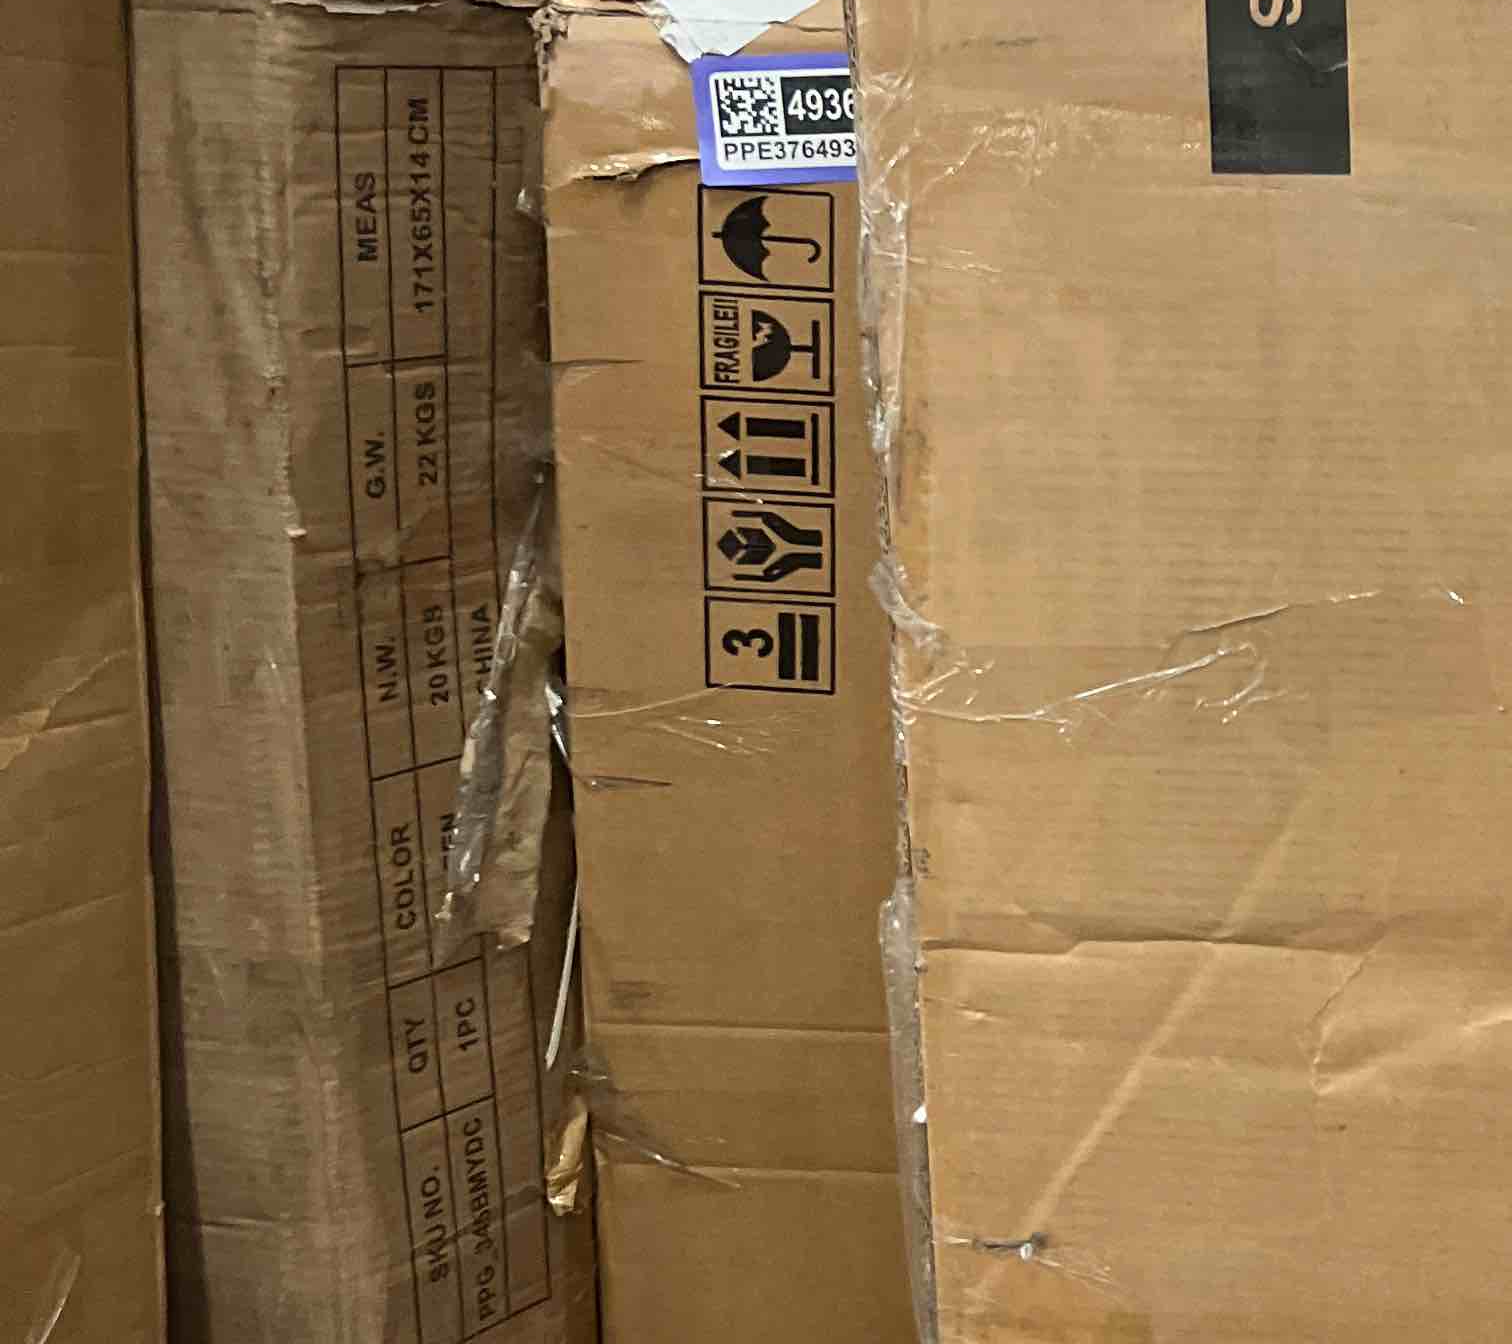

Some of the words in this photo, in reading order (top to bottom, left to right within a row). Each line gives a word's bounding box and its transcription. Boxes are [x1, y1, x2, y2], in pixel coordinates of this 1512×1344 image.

[408, 96, 429, 145] CM
[724, 139, 856, 161] PPE376493
[355, 172, 378, 262] MEAS
[409, 152, 434, 313] 171X65X14
[414, 381, 436, 447] KGS
[366, 432, 386, 498] G.W.
[417, 455, 438, 486] 22
[375, 635, 397, 703] N.W.
[721, 628, 774, 658] 3
[430, 673, 449, 706] 20
[391, 825, 416, 930] COLOR
[405, 1018, 428, 1074] QTY
[456, 997, 479, 1052] 1PC
[421, 1166, 444, 1220] NO.
[426, 1222, 449, 1283] SKU
